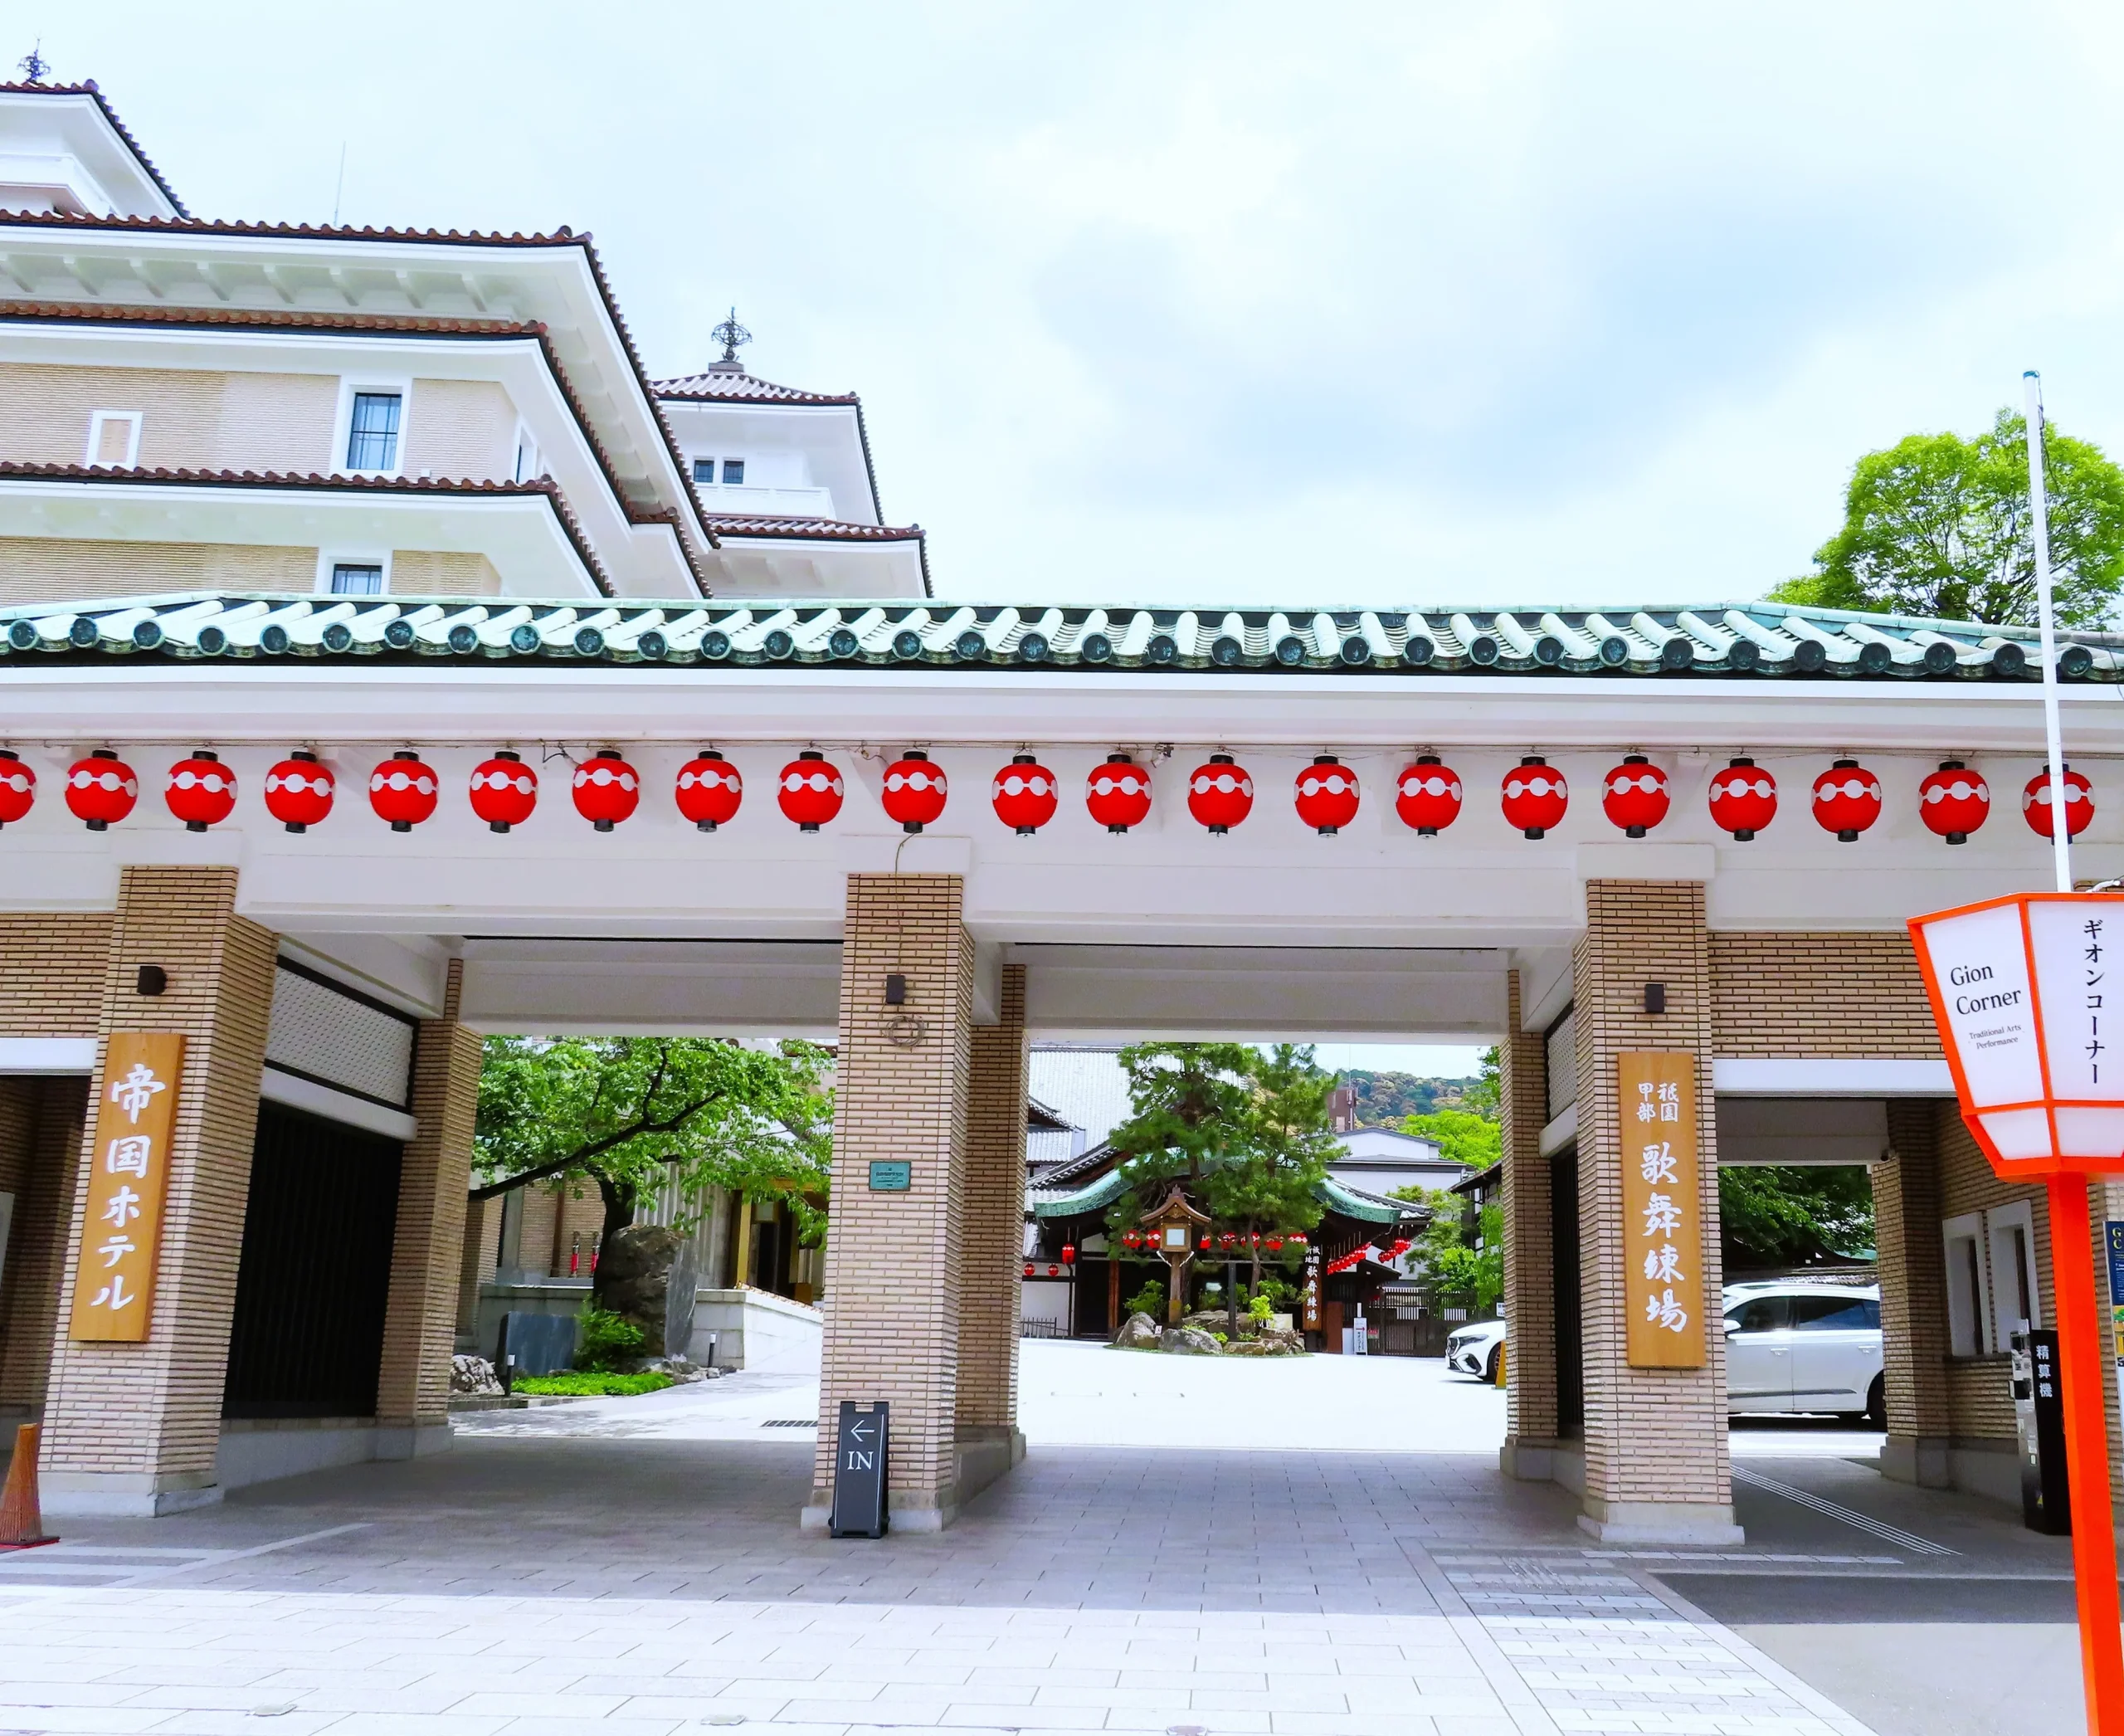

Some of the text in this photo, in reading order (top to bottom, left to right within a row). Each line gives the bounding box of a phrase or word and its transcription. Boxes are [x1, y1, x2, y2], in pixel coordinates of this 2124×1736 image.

[1950, 964, 1995, 987] Gion
[1956, 989, 2022, 1015] Corner
[2083, 919, 2106, 1085] ギオンコーナー
[1969, 1024, 2022, 1040] Traditional Arts
[1975, 1036, 2019, 1050] Performance
[90, 1062, 167, 1311] 帝国ホテル
[1639, 1141, 1688, 1333] 歌舞練場
[2035, 1344, 2053, 1398] 精算機
[846, 1451, 874, 1470] IN
